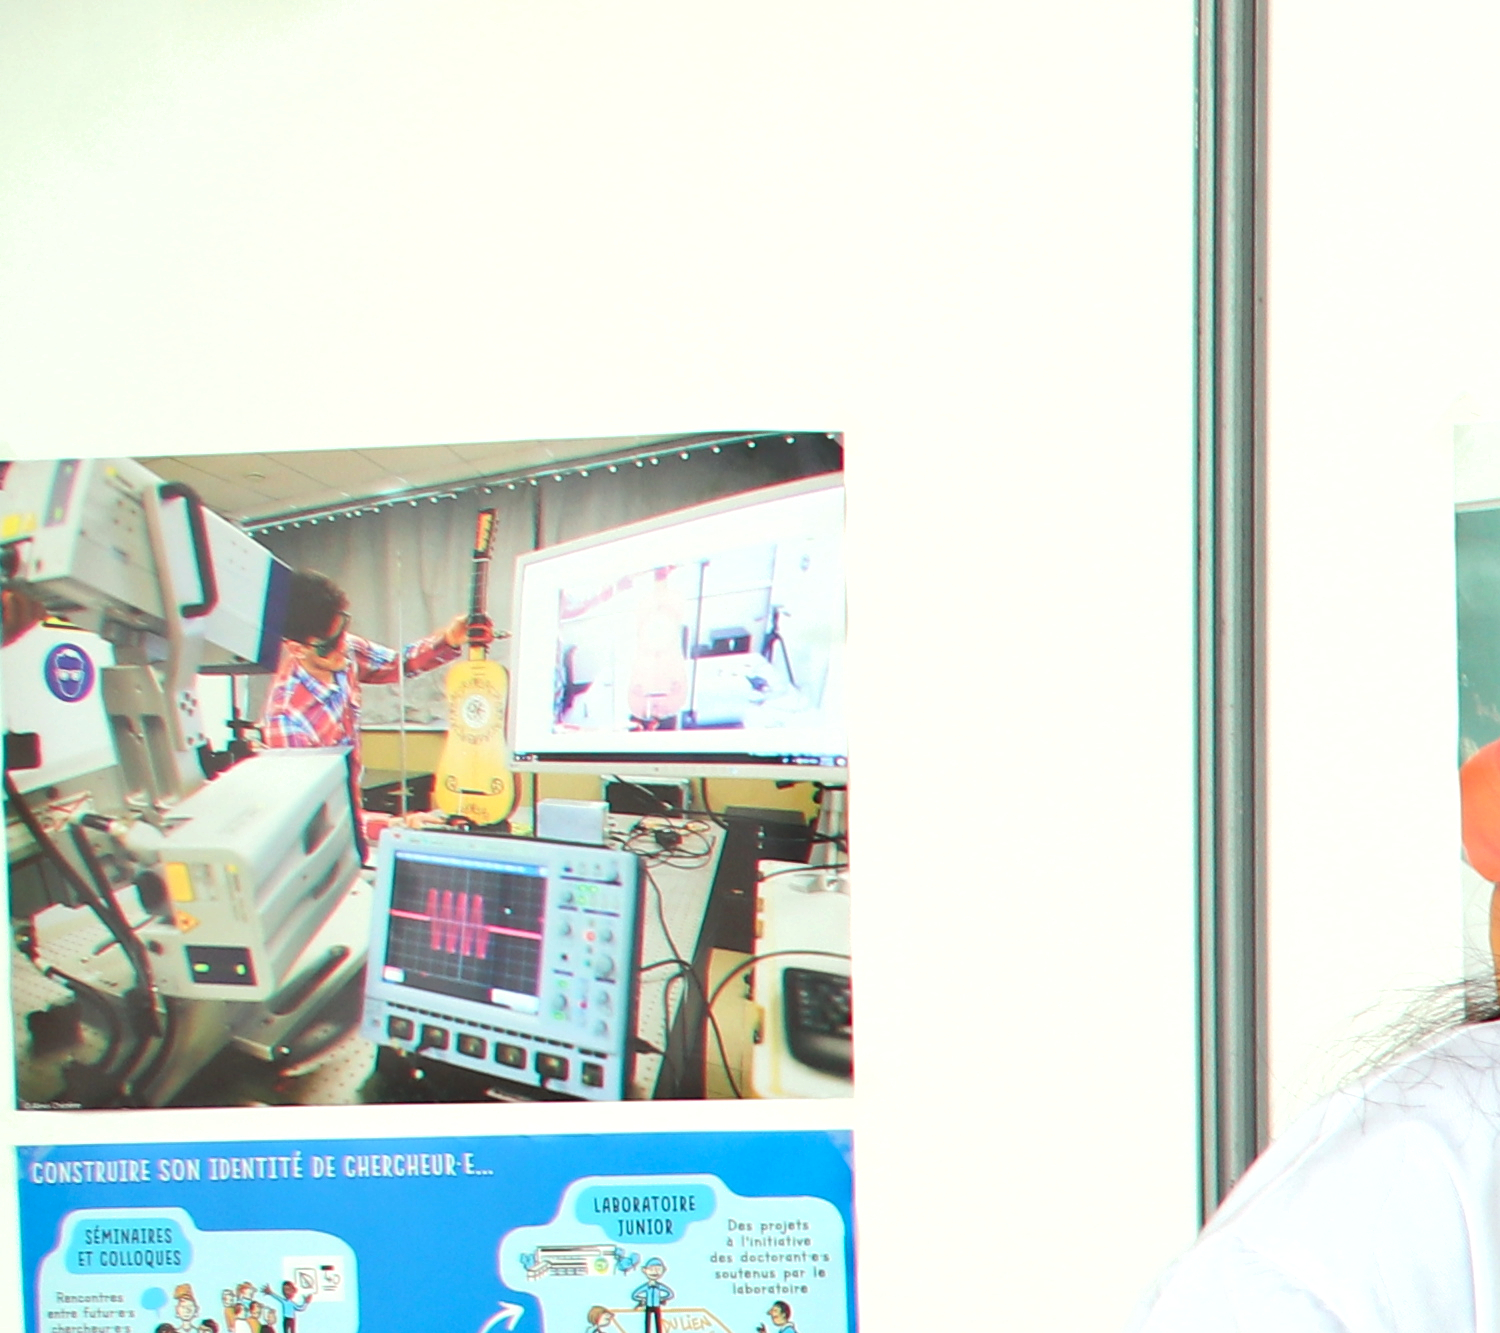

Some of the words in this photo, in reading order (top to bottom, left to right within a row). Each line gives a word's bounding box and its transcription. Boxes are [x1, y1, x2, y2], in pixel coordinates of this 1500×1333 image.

[30, 1160, 150, 1184] CONSTRUIRE
[157, 1159, 200, 1181] SON
[208, 1151, 303, 1181] IDENTITÉ
[311, 1156, 335, 1178] DE
[594, 1195, 696, 1214] LABORATOIRE
[85, 1226, 173, 1245] SÉMINAIRES
[618, 1219, 673, 1237] JUNIOR
[728, 1219, 753, 1231] Des
[761, 1219, 809, 1236] projets
[78, 1251, 94, 1266] ET
[100, 1250, 182, 1268] COLLOQUES
[715, 1269, 776, 1279] soutenus
[784, 1269, 805, 1282] par
[814, 1268, 826, 1278] le
[733, 1284, 808, 1294] laboratoire
